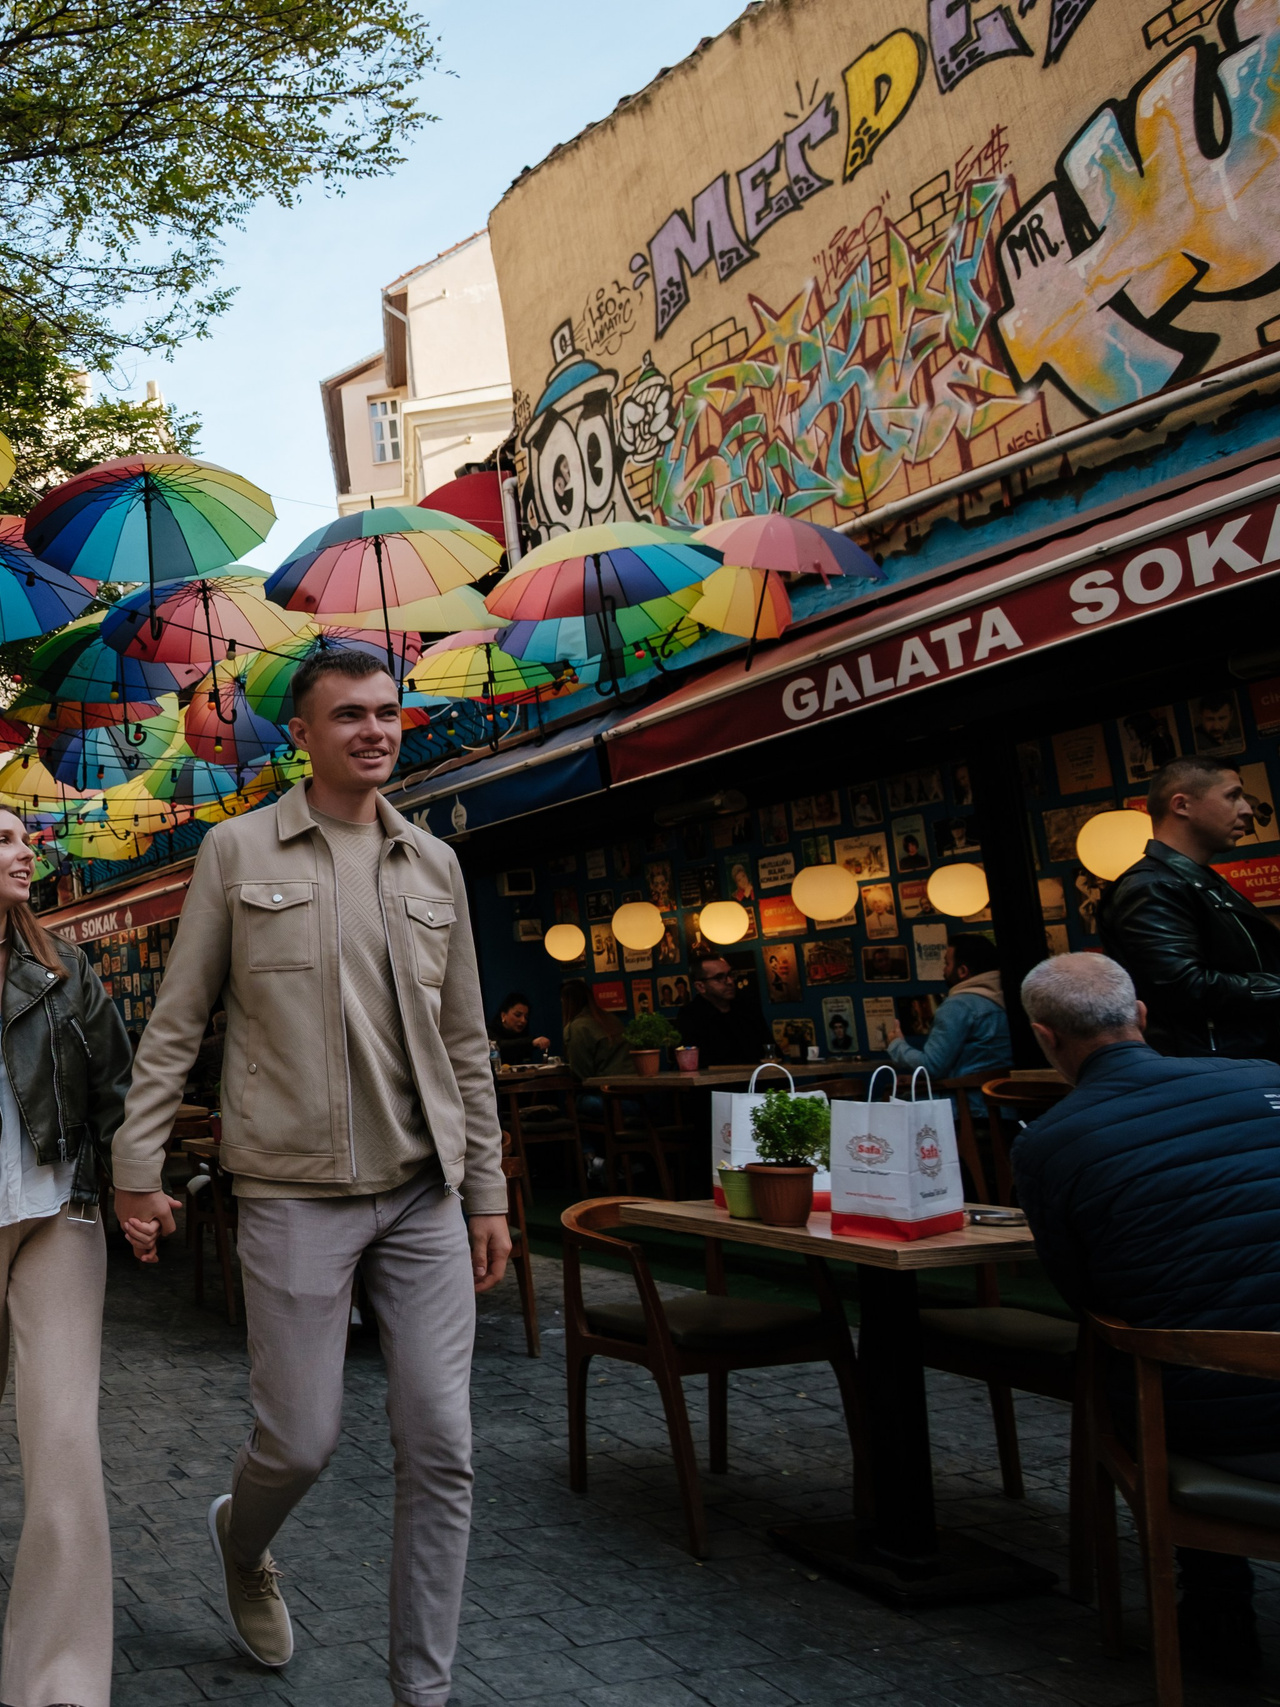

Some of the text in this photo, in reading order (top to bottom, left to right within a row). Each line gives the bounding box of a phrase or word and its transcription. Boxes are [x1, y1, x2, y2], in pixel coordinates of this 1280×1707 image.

[1006, 213, 1065, 280] MR.
[782, 504, 1280, 720] GALATA SOK
[1230, 864, 1280, 878] GALATA
[81, 912, 118, 939] SOKAK
[858, 1144, 882, 1156] Safa
[919, 1144, 939, 1160] Safa
